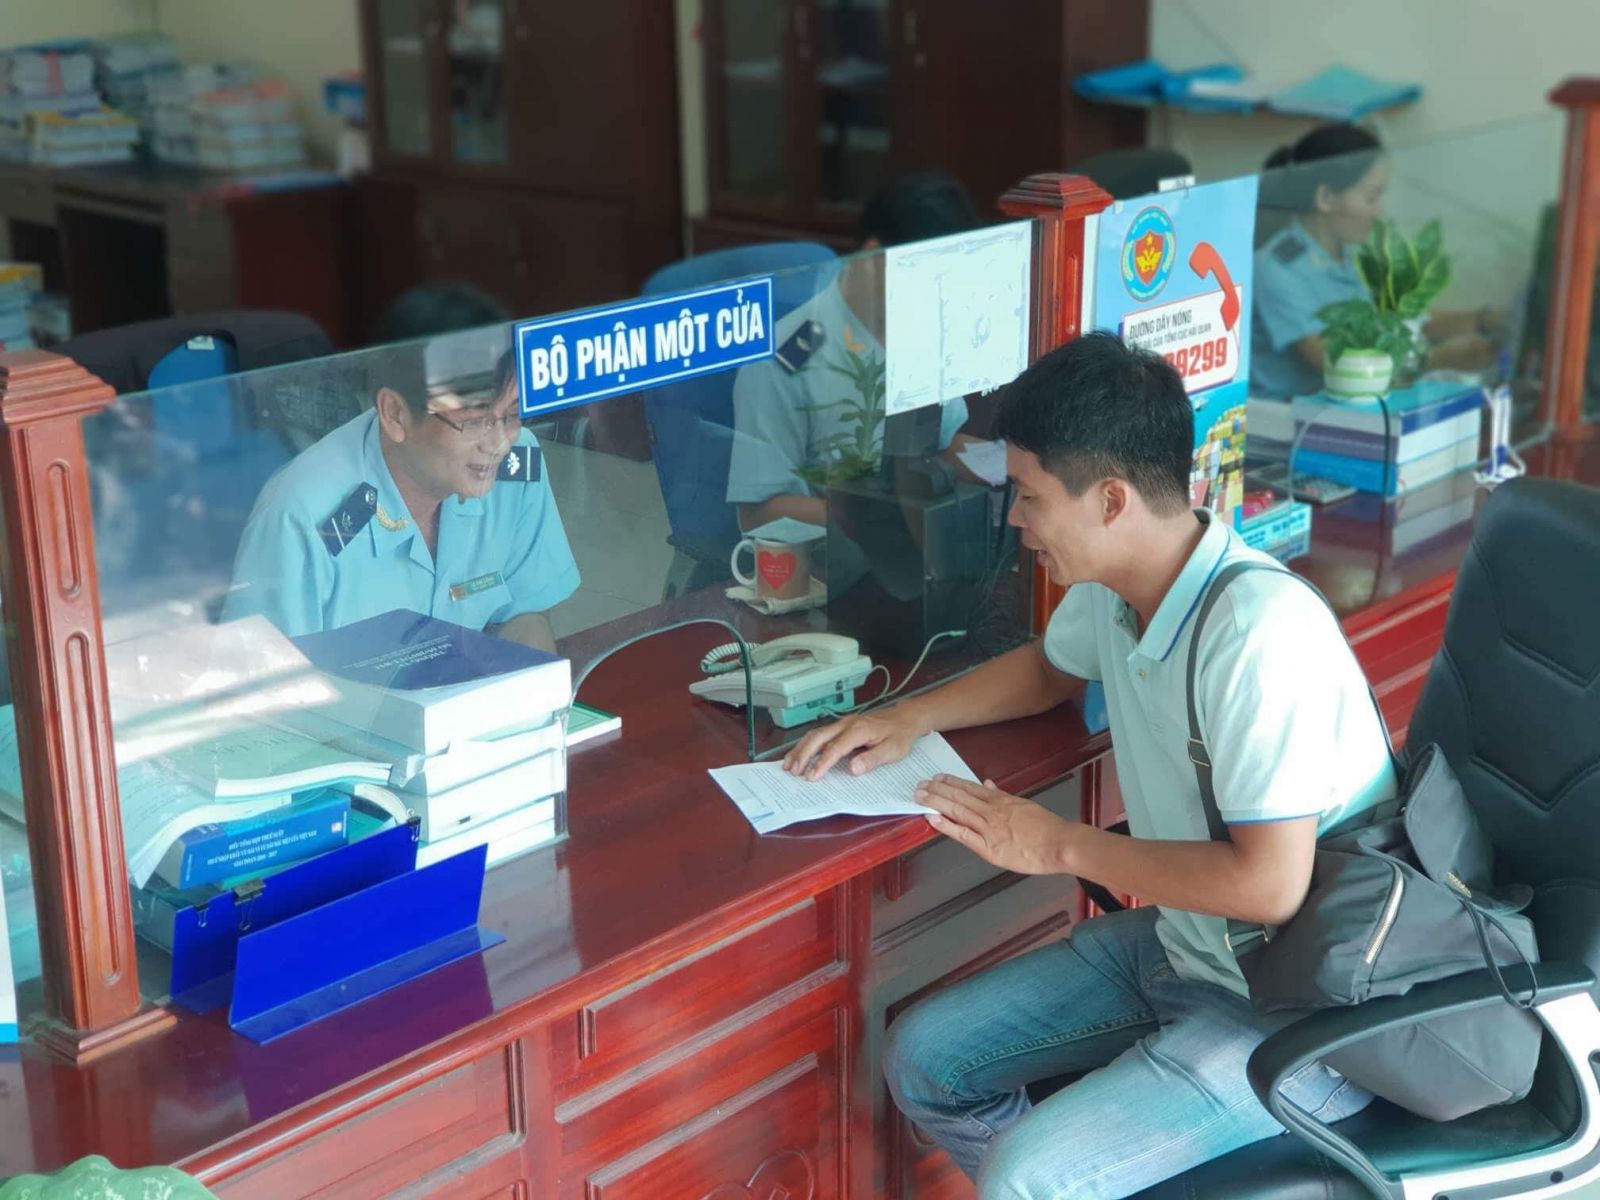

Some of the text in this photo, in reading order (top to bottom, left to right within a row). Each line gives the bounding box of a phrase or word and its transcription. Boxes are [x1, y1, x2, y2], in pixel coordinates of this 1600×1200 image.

[531, 289, 765, 397] BỘ PHẬN MỘT CỬA
